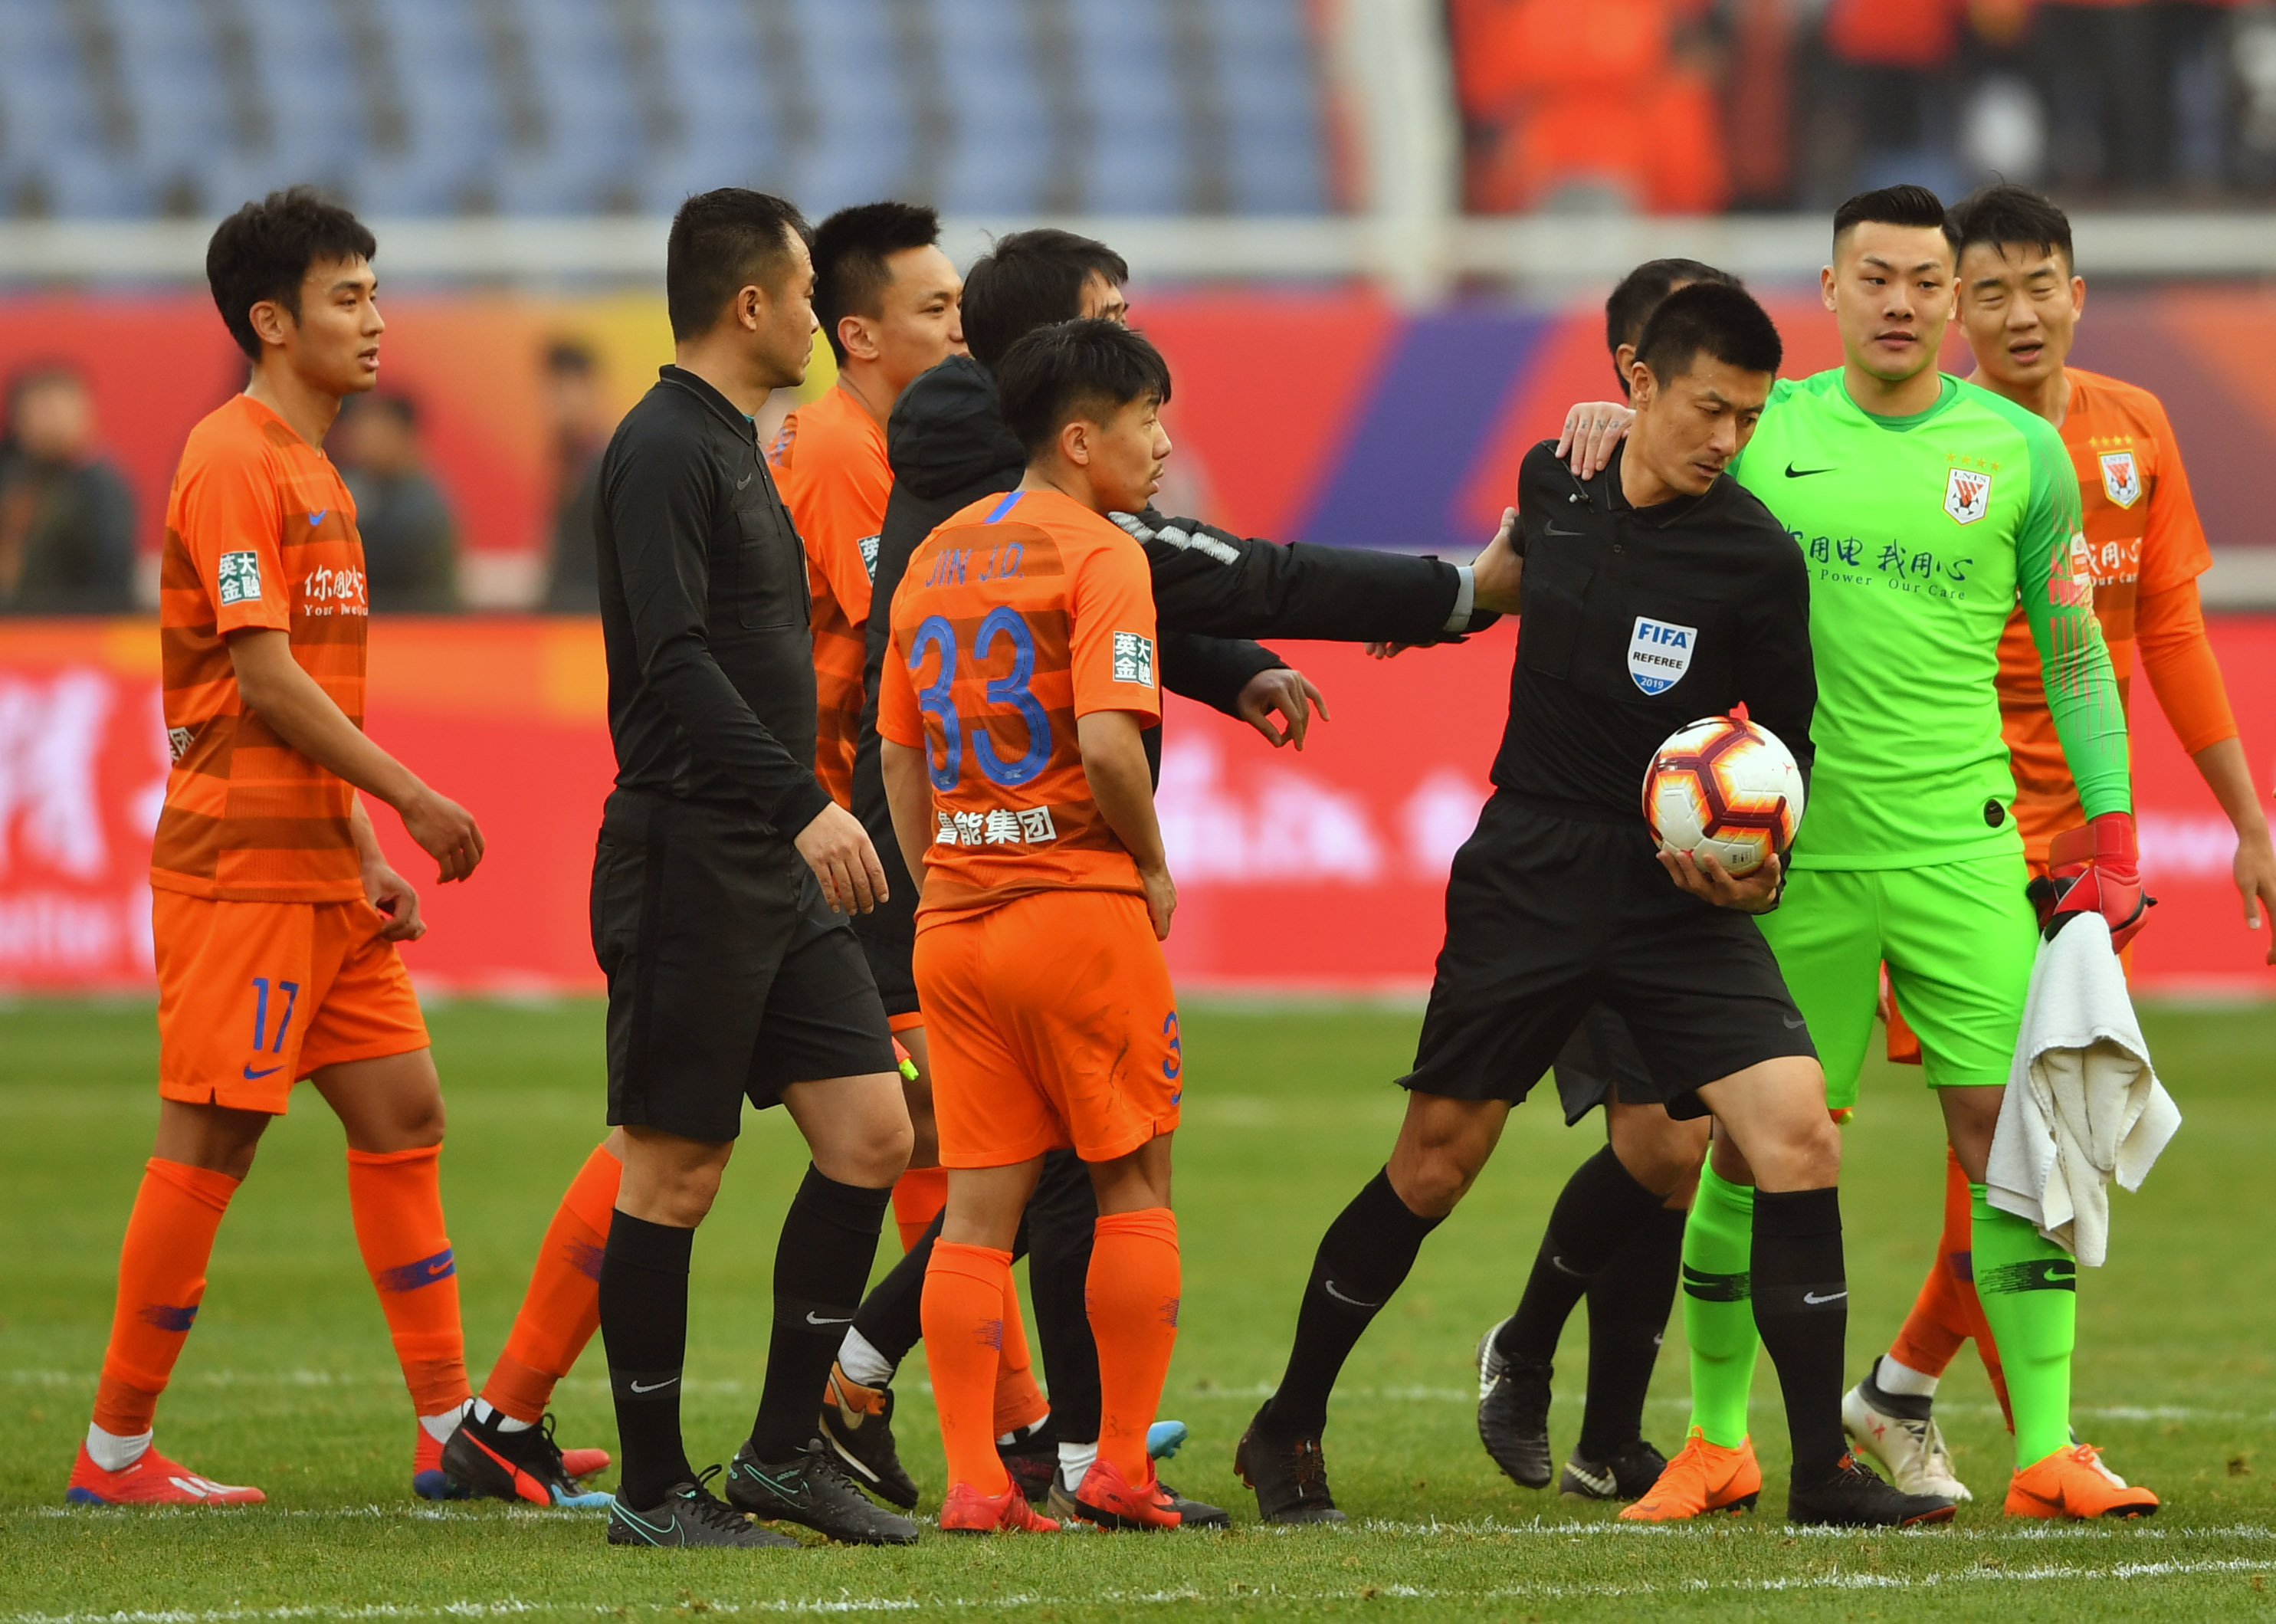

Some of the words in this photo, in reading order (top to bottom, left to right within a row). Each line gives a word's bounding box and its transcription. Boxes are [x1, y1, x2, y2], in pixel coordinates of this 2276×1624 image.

[1786, 523, 1863, 566] 用电
[925, 547, 972, 588] JIN
[979, 541, 1025, 581] J.D.
[1820, 569, 1872, 586] Power
[1888, 577, 1921, 593] Our
[1928, 584, 1966, 600] Care
[303, 604, 333, 616] Your
[1638, 622, 1687, 649] FIFA
[1632, 651, 1684, 670] REFEREE
[909, 605, 1053, 792] 33
[1640, 677, 1664, 690] 2019
[251, 976, 299, 1054] 17
